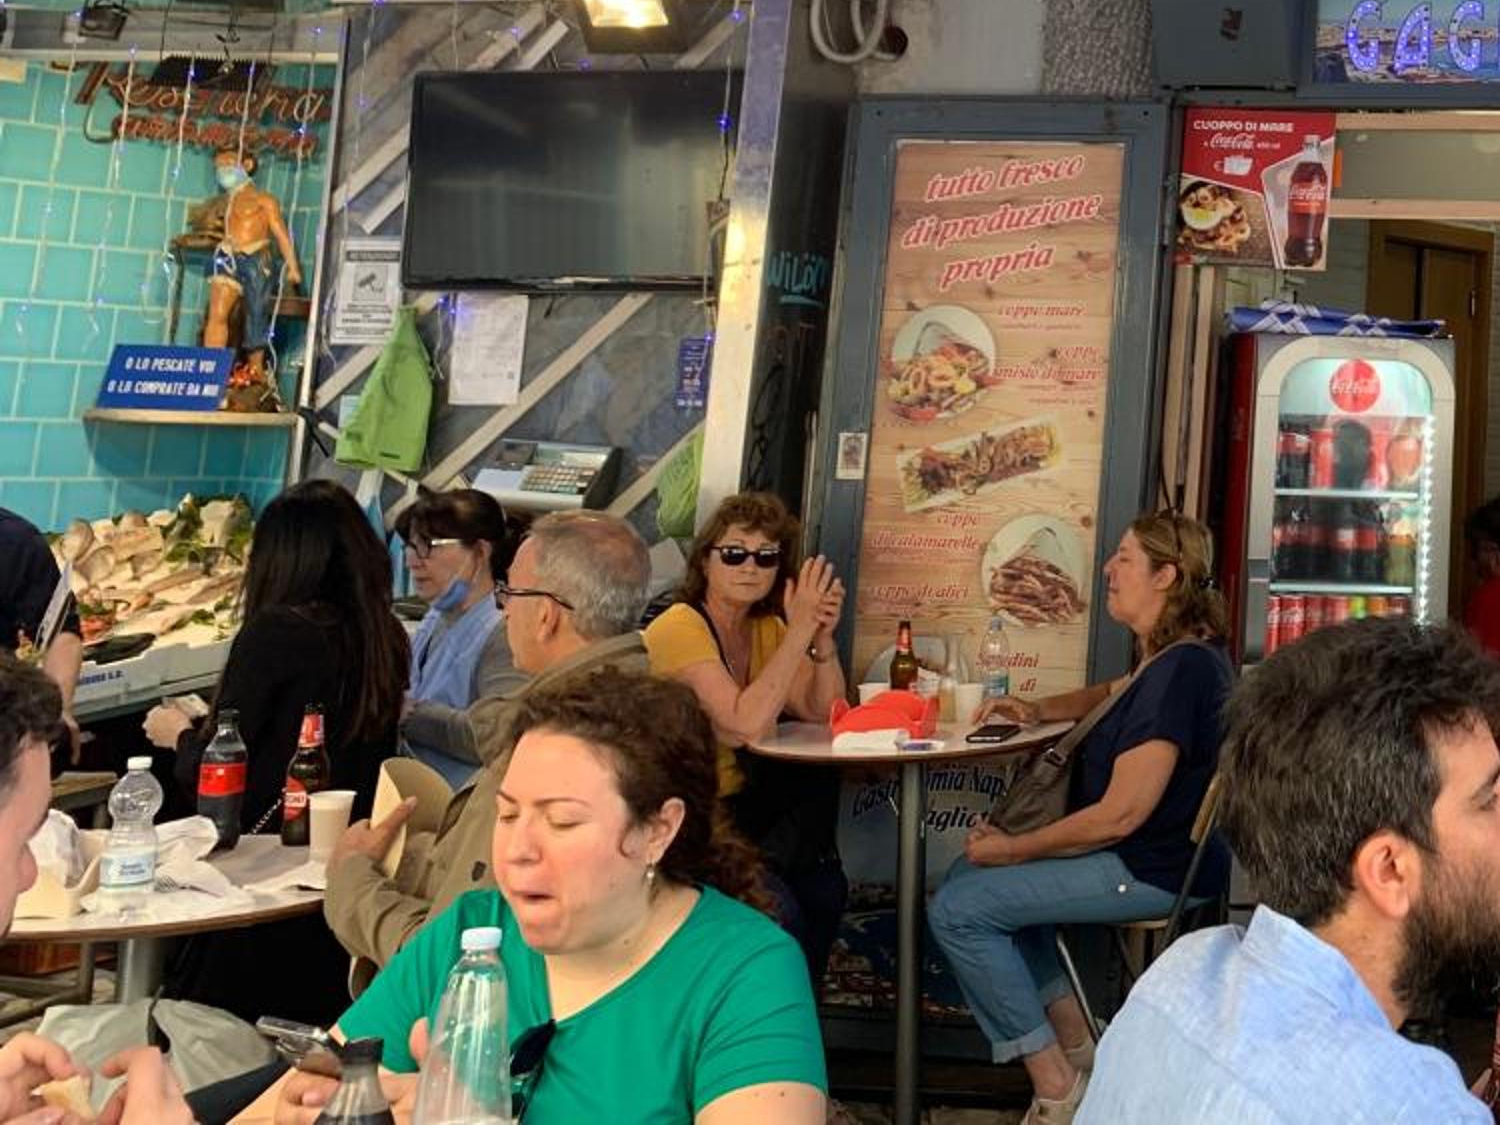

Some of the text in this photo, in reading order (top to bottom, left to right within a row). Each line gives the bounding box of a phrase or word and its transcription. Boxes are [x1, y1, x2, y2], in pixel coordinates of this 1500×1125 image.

[1193, 120, 1243, 131] CUOPPO
[1245, 121, 1257, 131] DI
[925, 154, 1085, 203] tutto fresco
[935, 195, 1103, 249] produzione
[940, 243, 1055, 291] propria
[151, 357, 197, 372] PESCATE
[199, 359, 217, 373] VOI
[133, 380, 184, 395] COMPRATE
